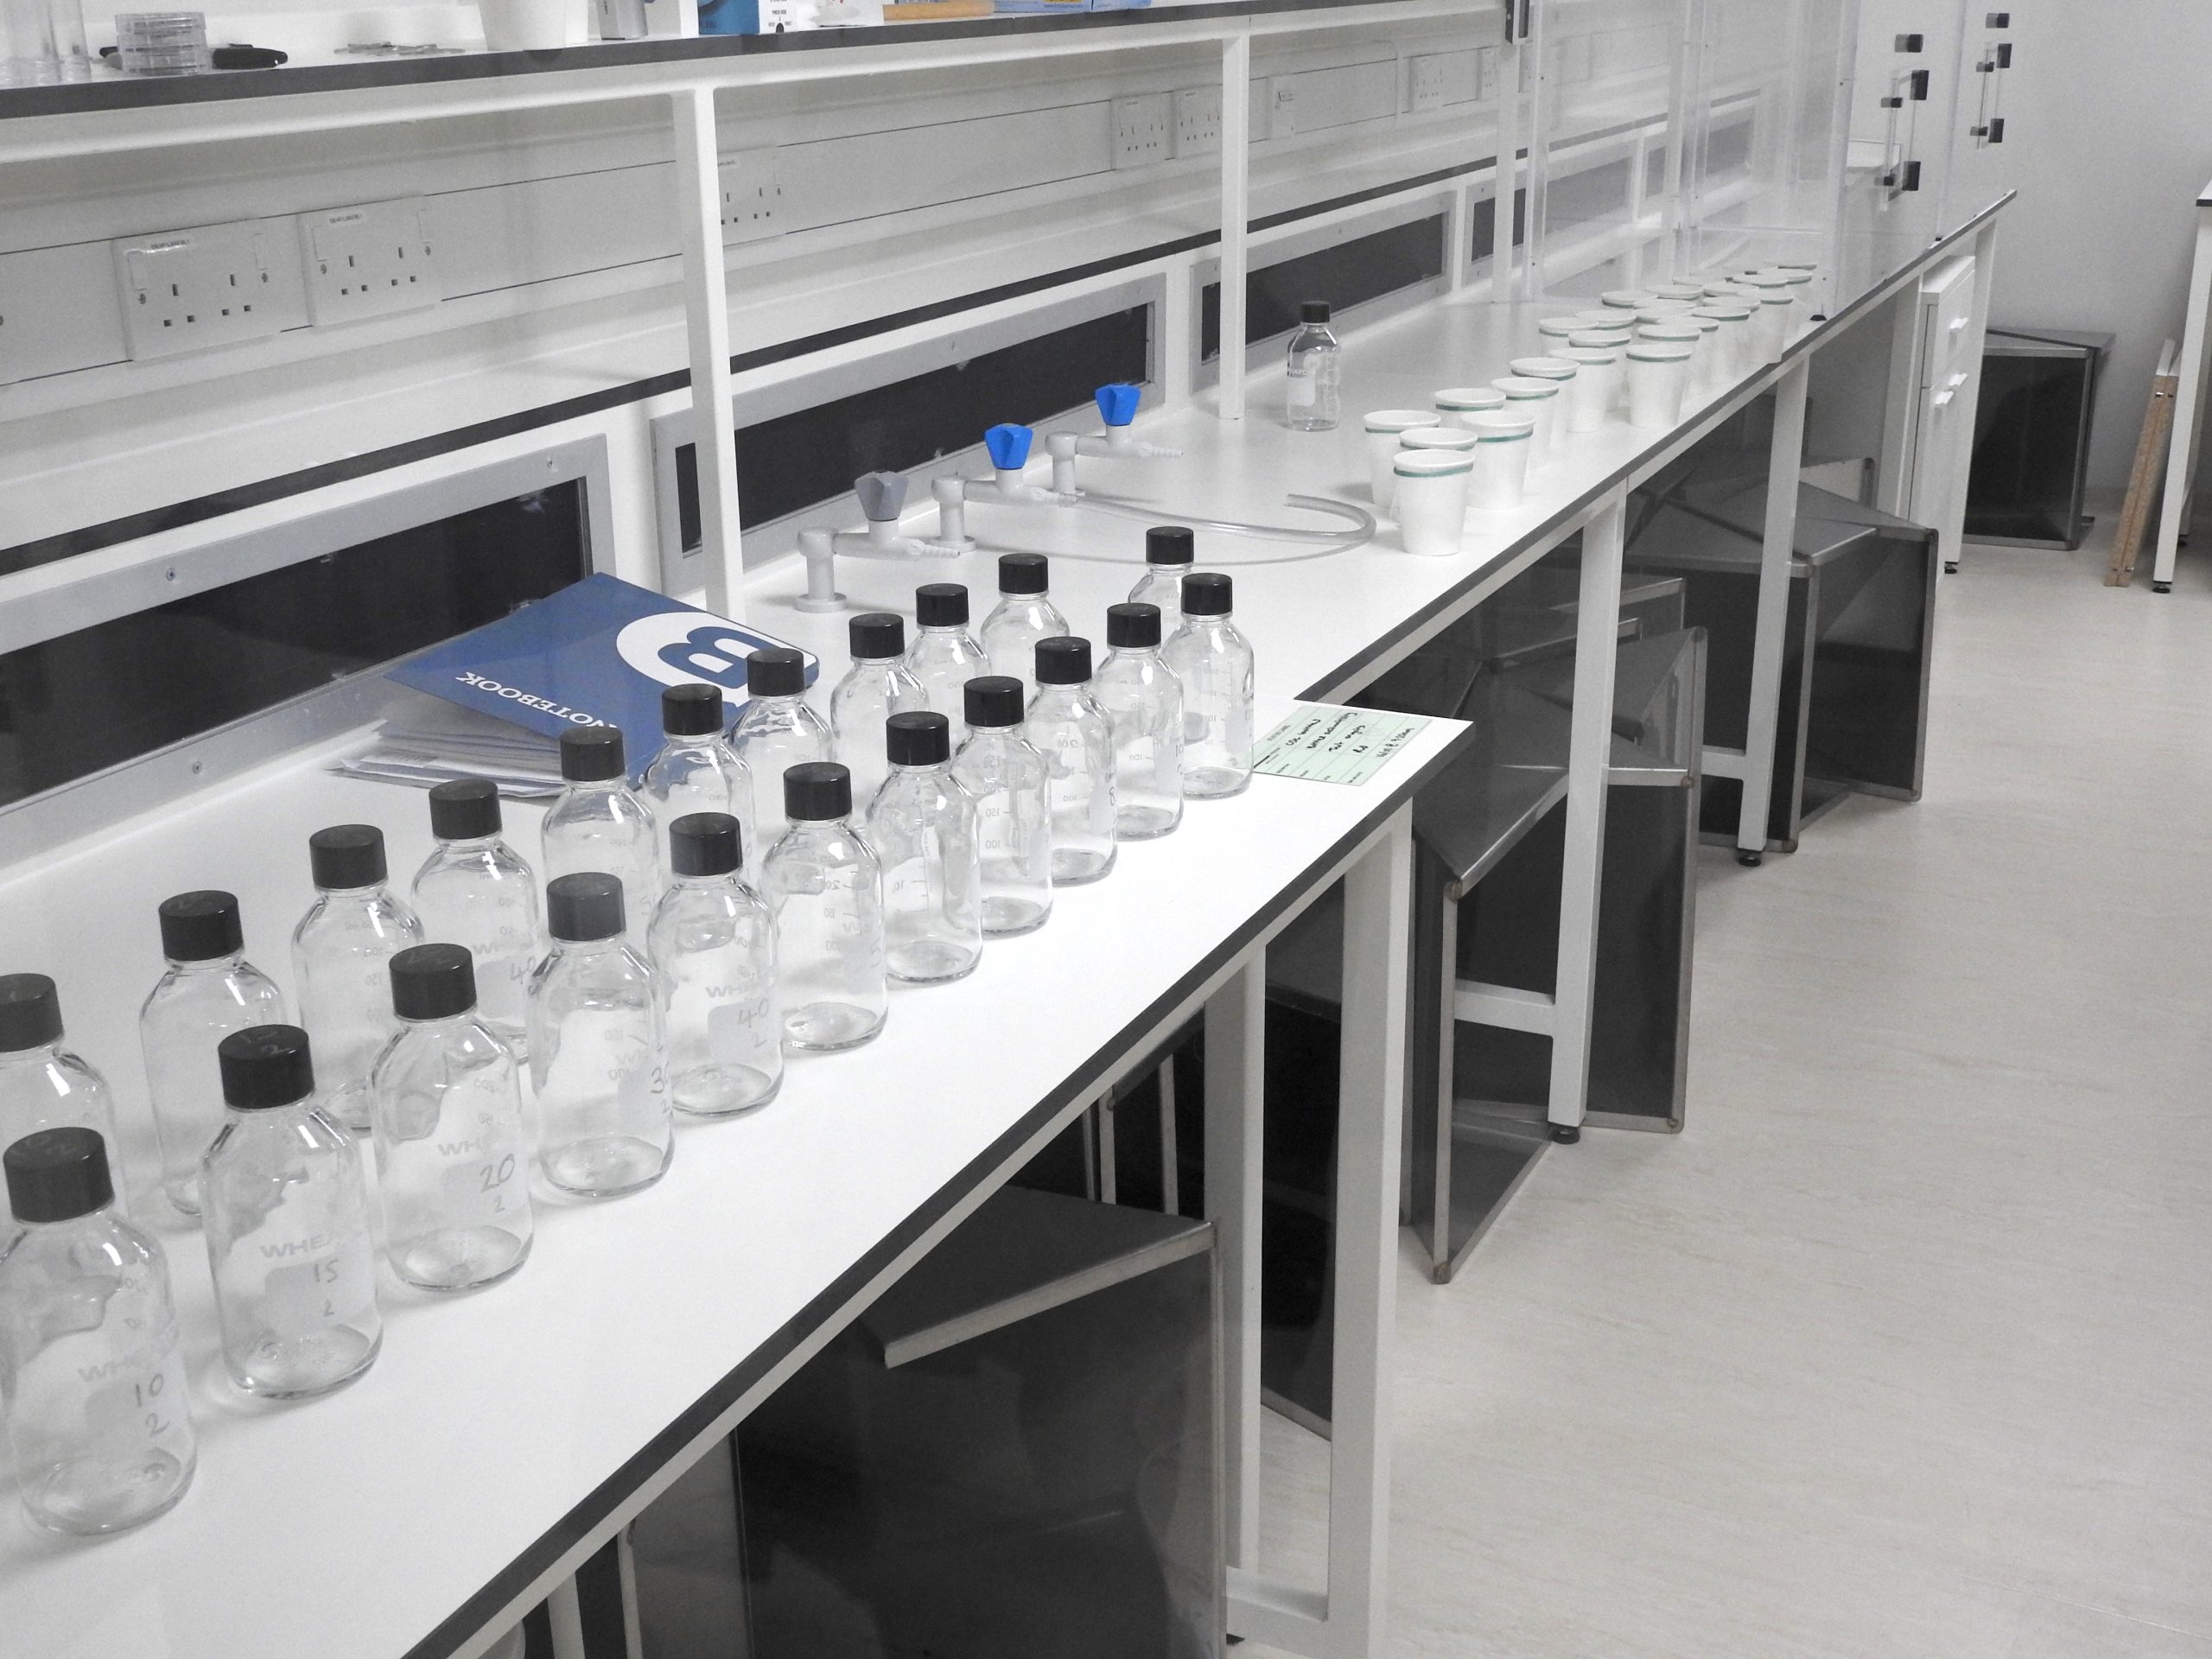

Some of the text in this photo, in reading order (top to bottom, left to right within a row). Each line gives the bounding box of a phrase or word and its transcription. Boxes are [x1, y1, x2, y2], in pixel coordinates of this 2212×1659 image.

[480, 1153, 516, 1193] 20
[313, 1258, 340, 1283] 15
[135, 1373, 165, 1408] 10
[145, 1412, 171, 1438] 2
